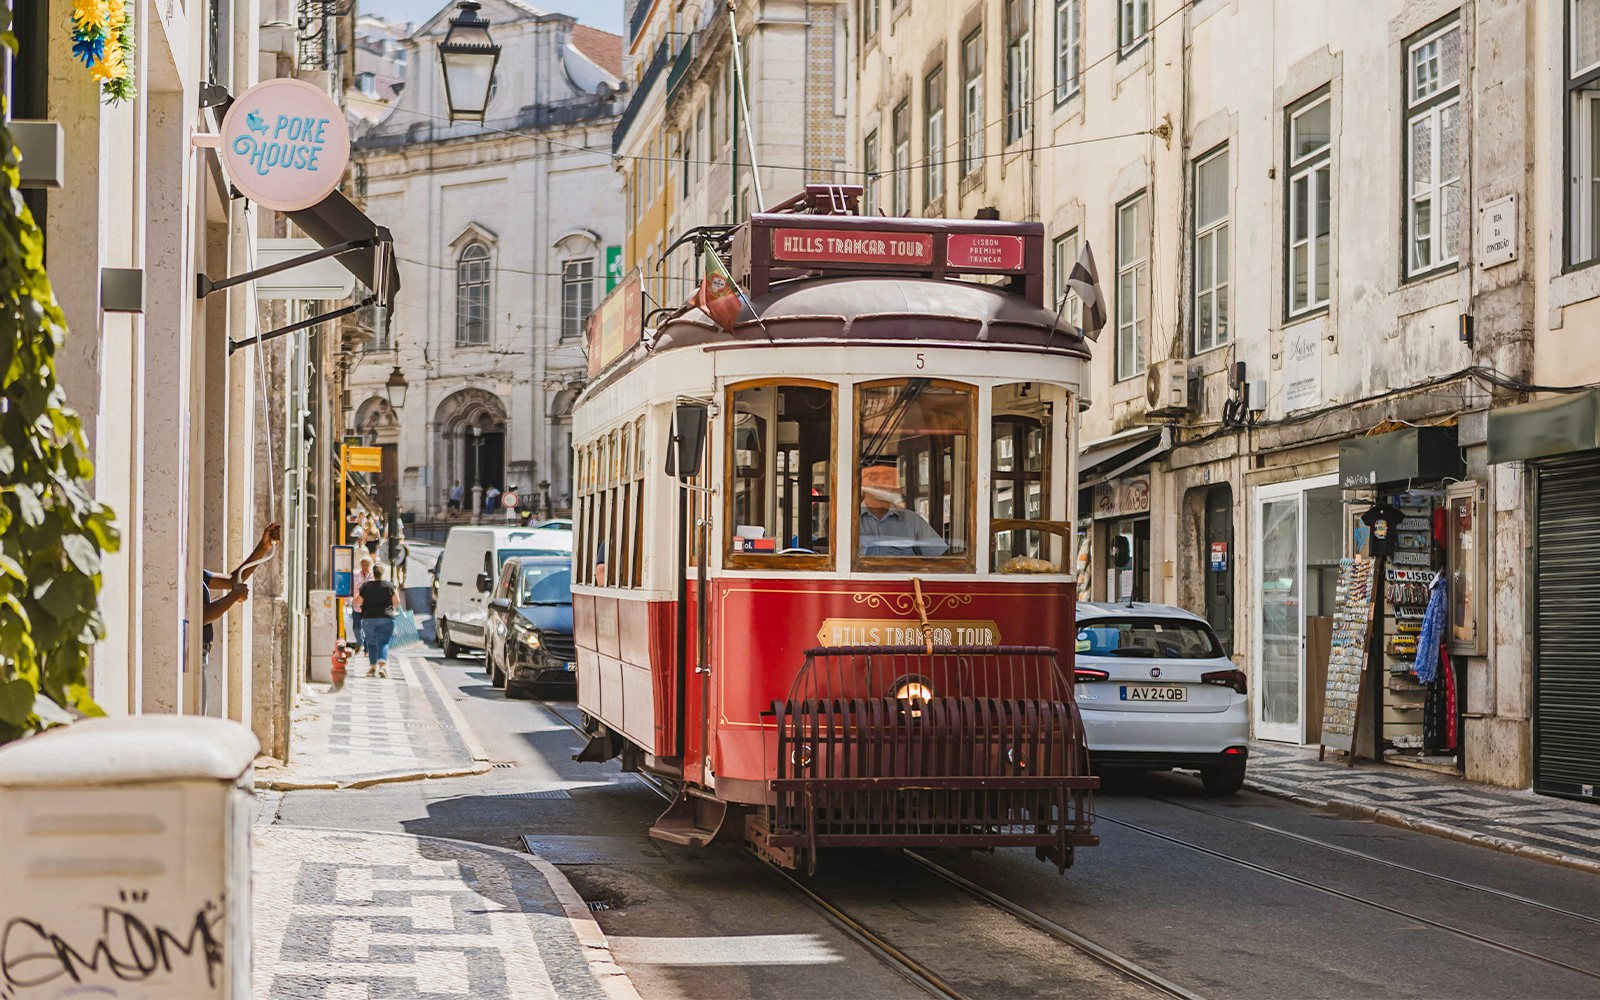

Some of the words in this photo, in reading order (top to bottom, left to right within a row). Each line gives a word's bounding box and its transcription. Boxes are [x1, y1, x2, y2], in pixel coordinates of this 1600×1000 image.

[273, 115, 330, 143] POKE
[232, 134, 322, 176] HOUSE
[783, 236, 824, 253] HILLS
[827, 237, 886, 256] TRAMCAR
[889, 240, 924, 257] TOUR
[969, 247, 1002, 255] PREMIUM
[972, 238, 999, 246] LISBON
[969, 255, 1002, 263] TRAMCAR
[916, 353, 925, 370] 5
[832, 626, 881, 646] HILLS
[956, 627, 993, 647] TOUR
